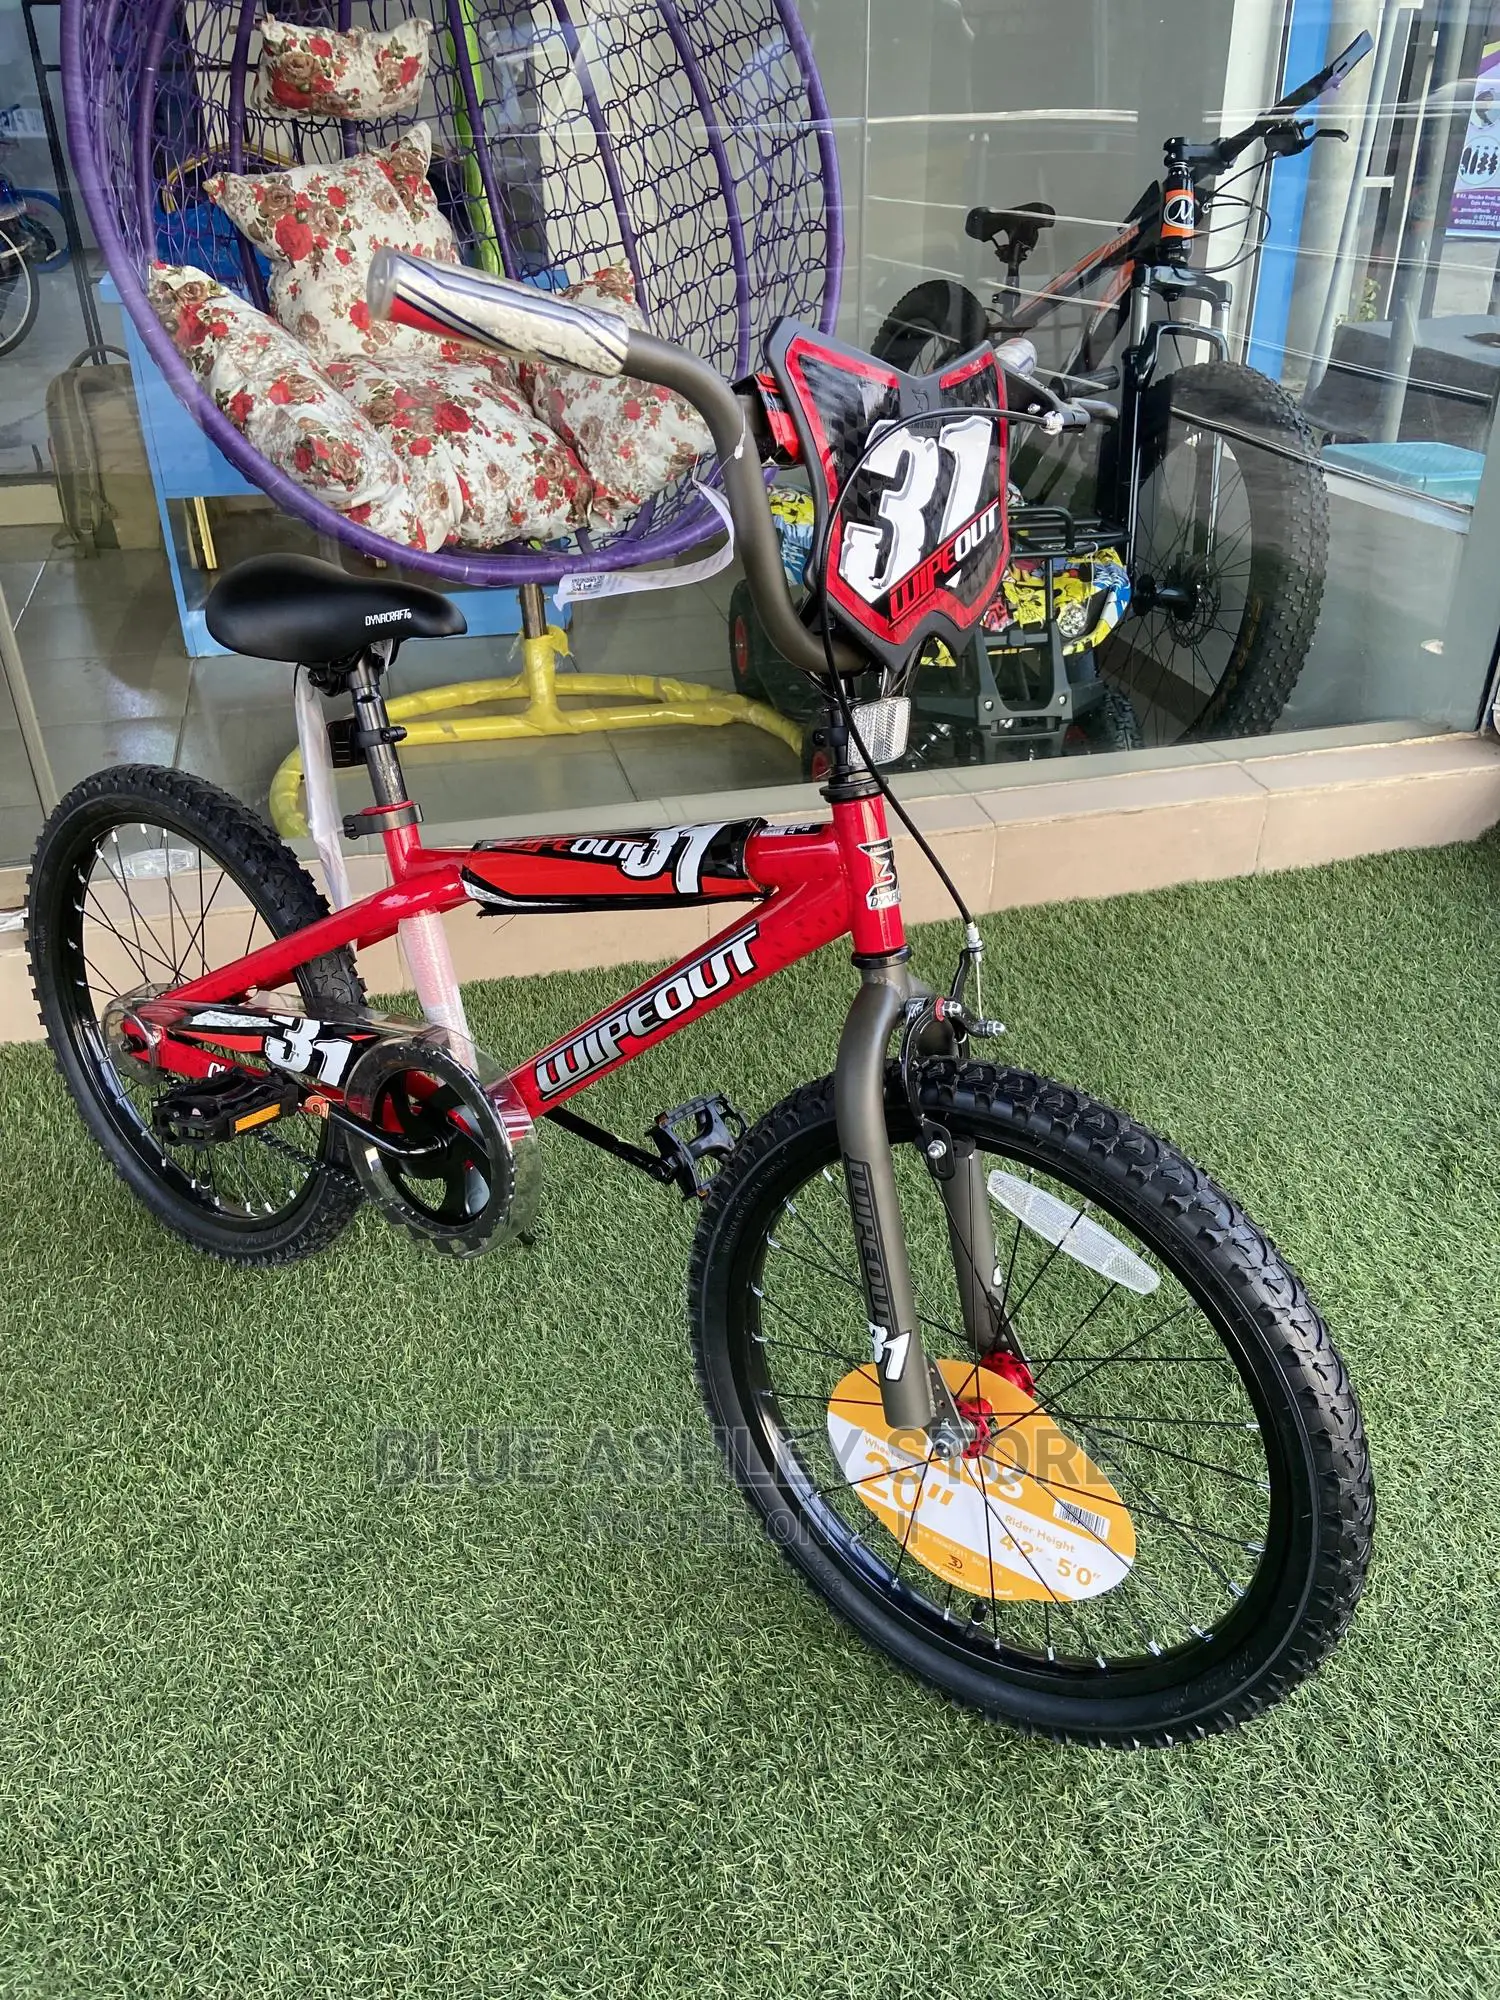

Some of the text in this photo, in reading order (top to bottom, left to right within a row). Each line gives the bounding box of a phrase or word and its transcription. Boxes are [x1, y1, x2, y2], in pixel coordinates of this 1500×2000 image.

[838, 415, 993, 604] 31
[890, 502, 999, 619] WIPEOUT
[536, 927, 757, 1097] WIPEOUT
[264, 1014, 353, 1087] 31
[858, 1451, 954, 1512] 20"
[1004, 1513, 1076, 1553] Rider Height
[1057, 1557, 1102, 1586] 5'0"
